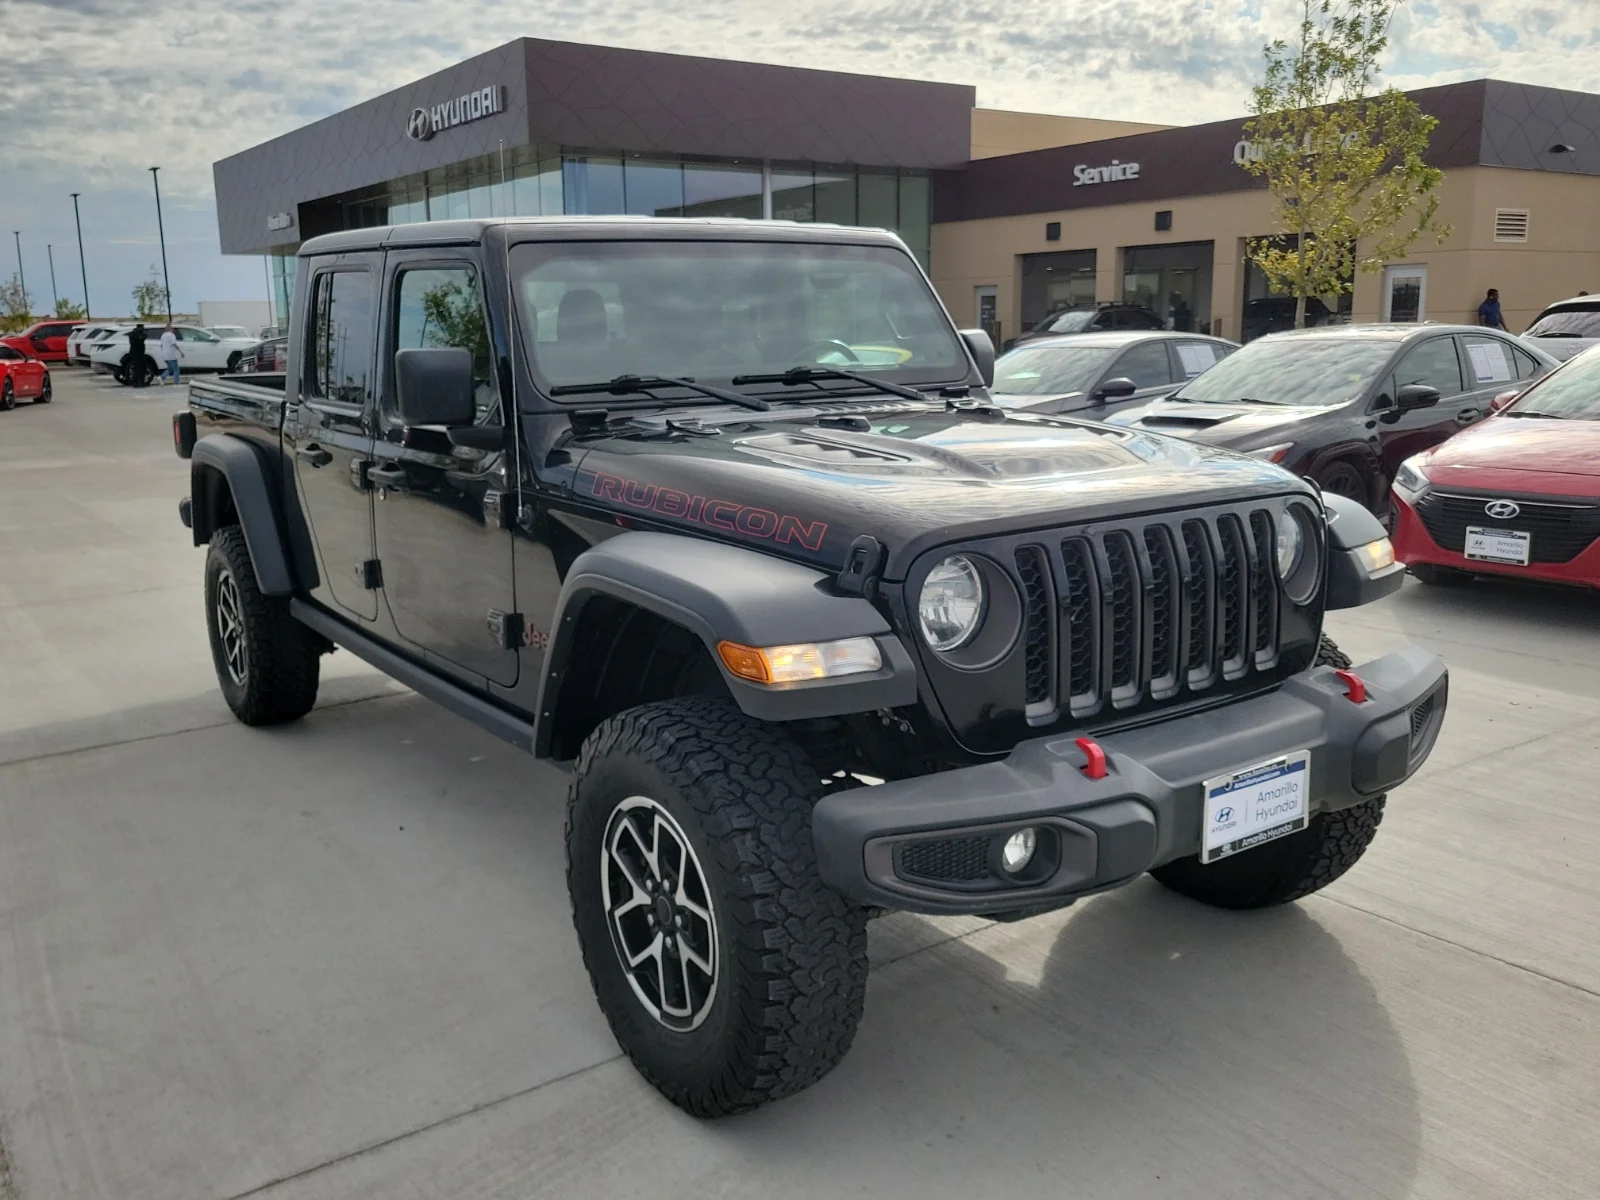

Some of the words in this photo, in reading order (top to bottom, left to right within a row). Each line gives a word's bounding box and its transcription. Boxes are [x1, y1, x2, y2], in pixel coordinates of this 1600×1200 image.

[431, 84, 499, 132] HYUNDAI
[1072, 159, 1140, 186] Service
[591, 471, 828, 551] RUBICON
[522, 622, 550, 650] Jee
[1256, 781, 1299, 804] Amarillo
[1255, 796, 1298, 822] Hyundai
[1211, 820, 1238, 834] HYUNDAI
[1241, 831, 1267, 848] Amarillo
[1267, 821, 1293, 839] Hyundai
